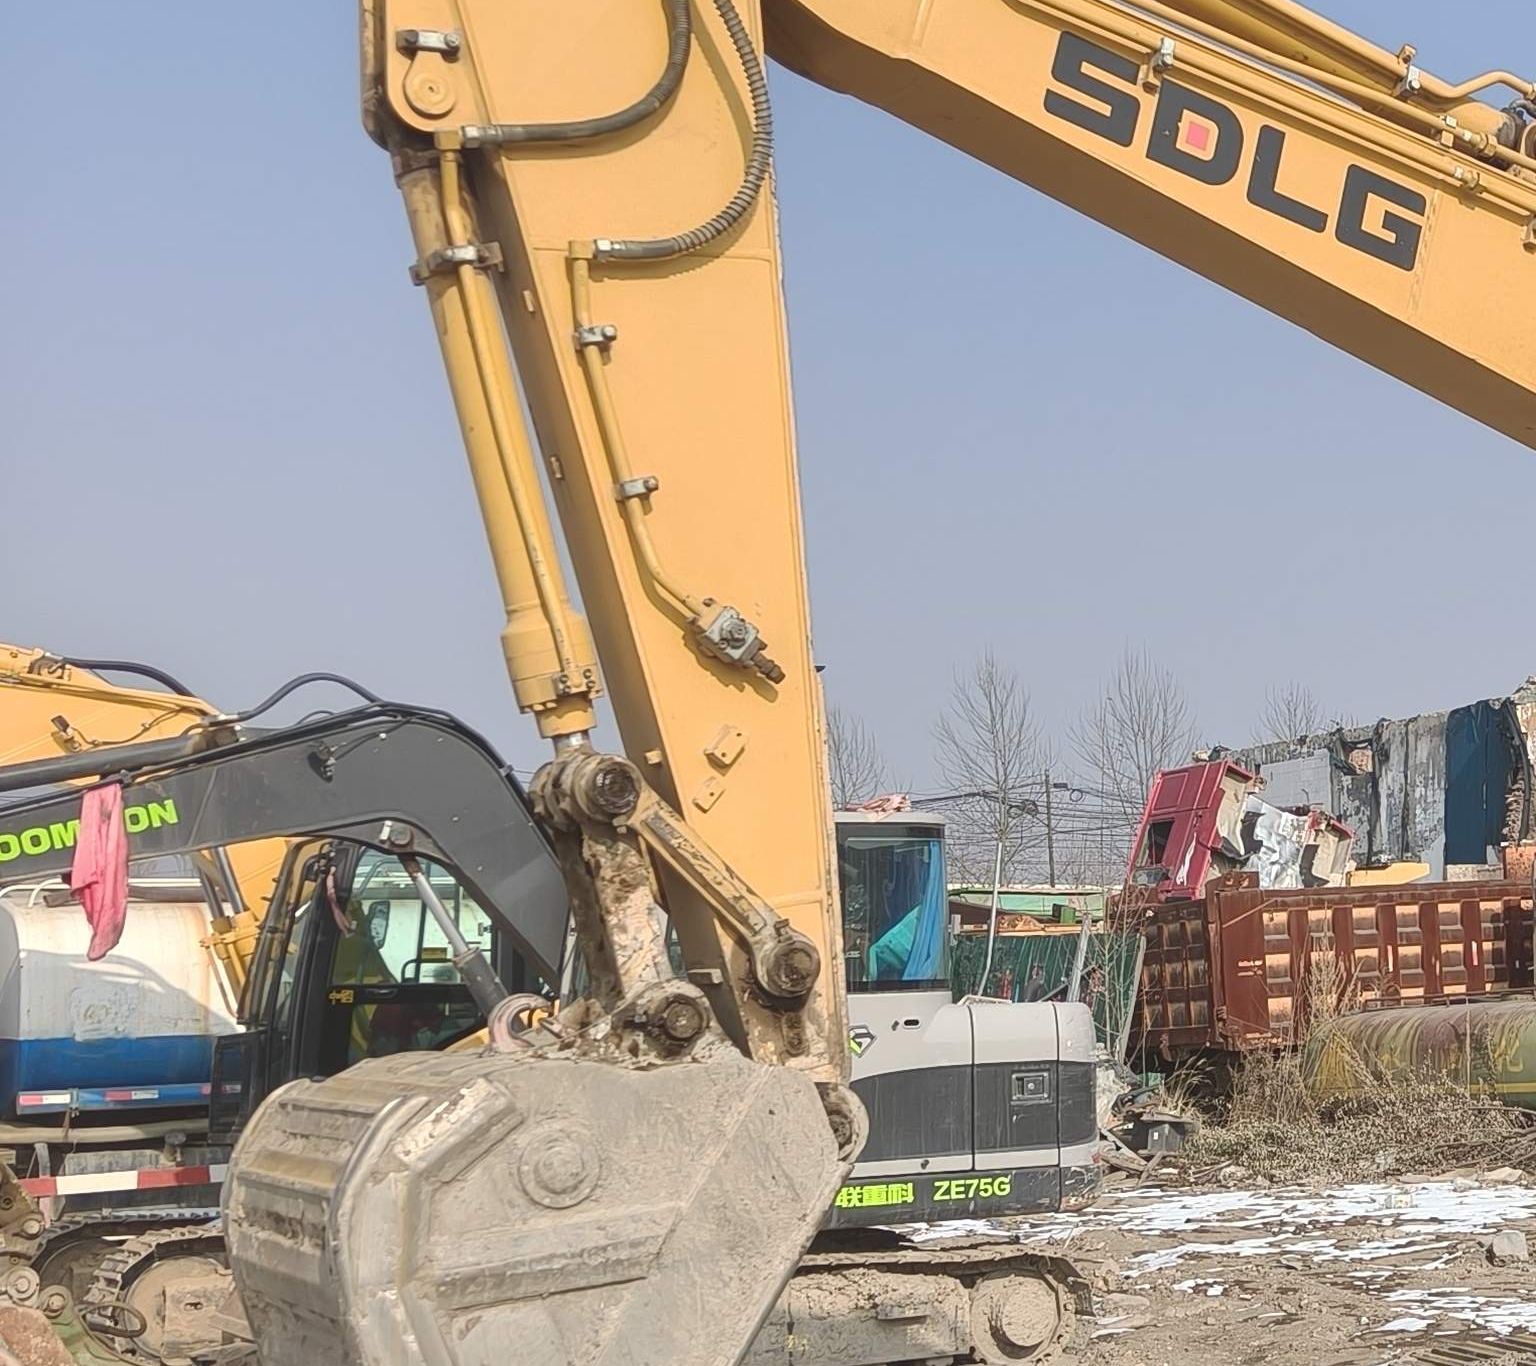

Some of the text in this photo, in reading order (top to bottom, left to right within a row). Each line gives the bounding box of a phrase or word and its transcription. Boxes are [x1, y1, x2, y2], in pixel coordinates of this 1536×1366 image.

[1043, 30, 1427, 272] SDLG
[0, 799, 179, 861] OOMON
[933, 1177, 1011, 1201] ZE75G
